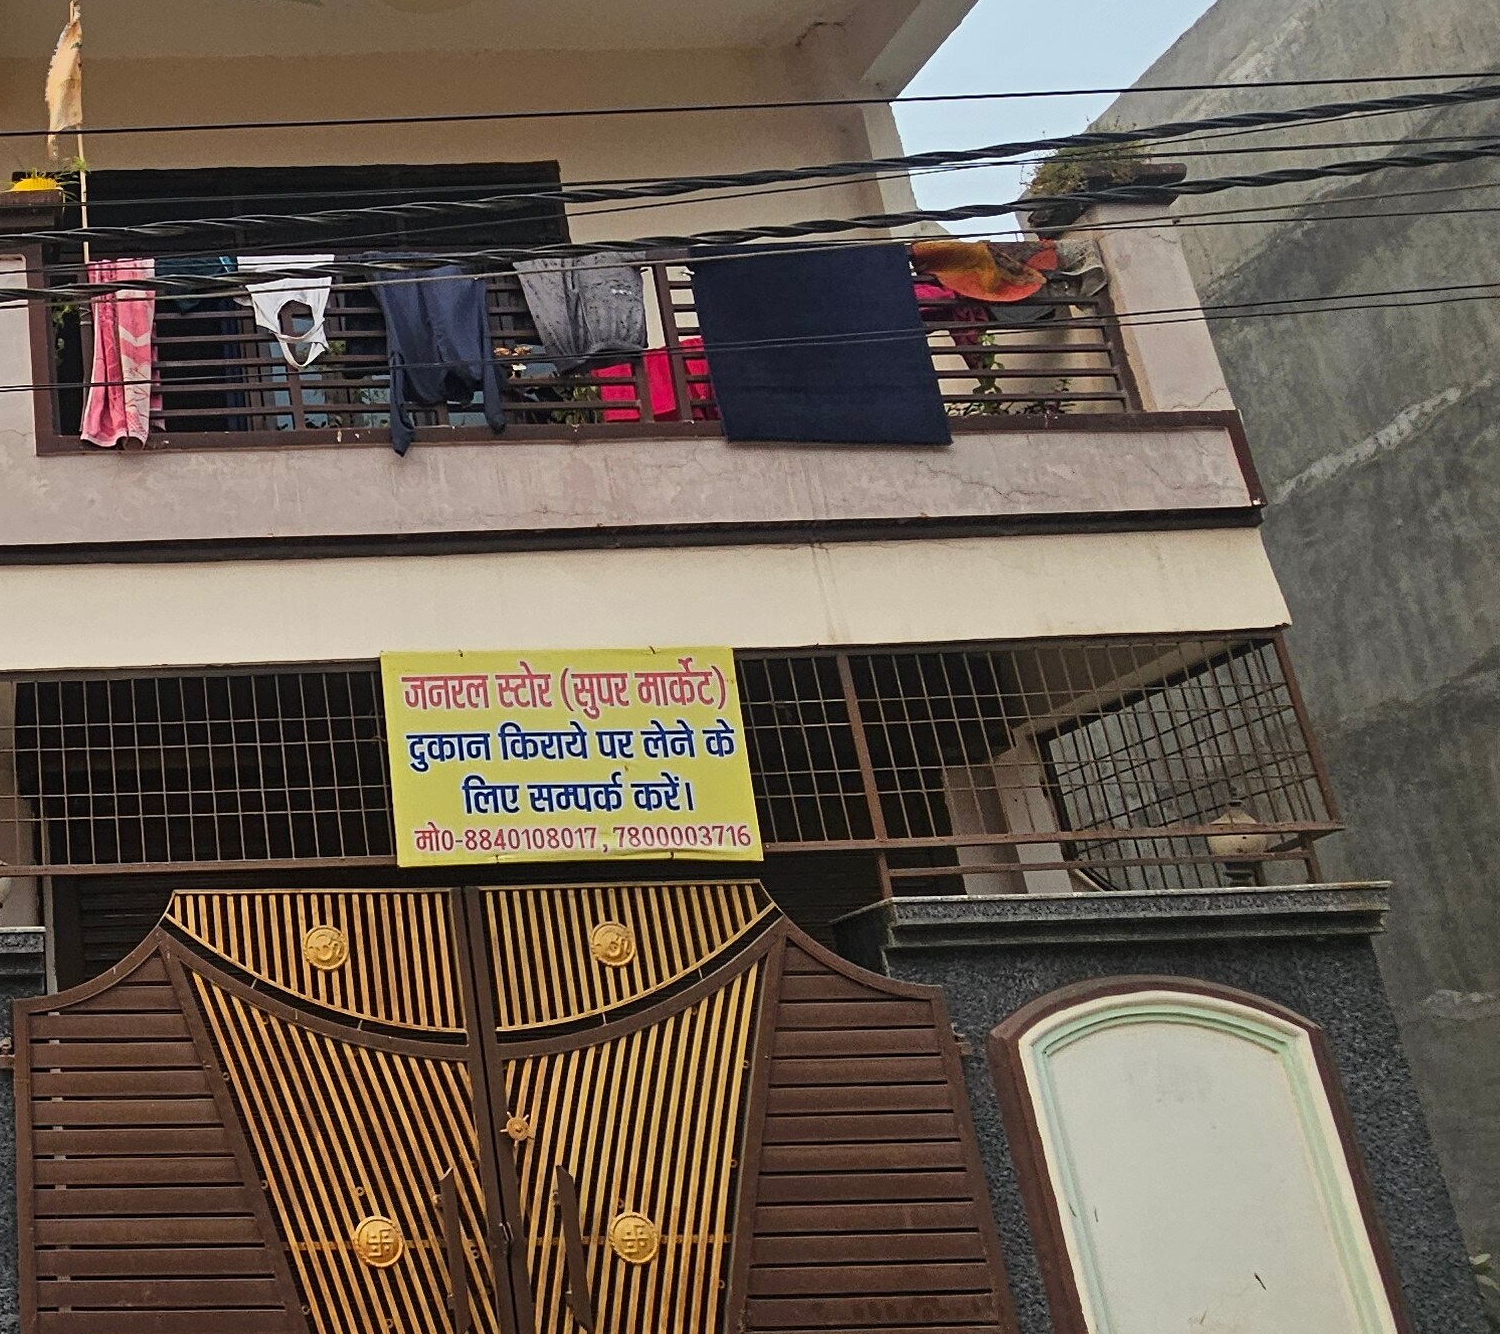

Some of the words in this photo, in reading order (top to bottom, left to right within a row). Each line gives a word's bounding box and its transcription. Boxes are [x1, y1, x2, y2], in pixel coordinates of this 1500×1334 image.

[402, 675, 489, 710] जनरल
[495, 661, 552, 709] स्टोर
[560, 667, 629, 719] (सुपर
[635, 658, 726, 710] मार्केट)
[406, 732, 491, 771] दुकान
[498, 720, 588, 760] किराये
[596, 730, 633, 759] पर
[642, 720, 695, 759] लेने
[703, 719, 735, 757] के
[462, 775, 520, 814] लिए
[527, 772, 623, 813] सम्पर्क
[612, 824, 752, 849] 7800003716
